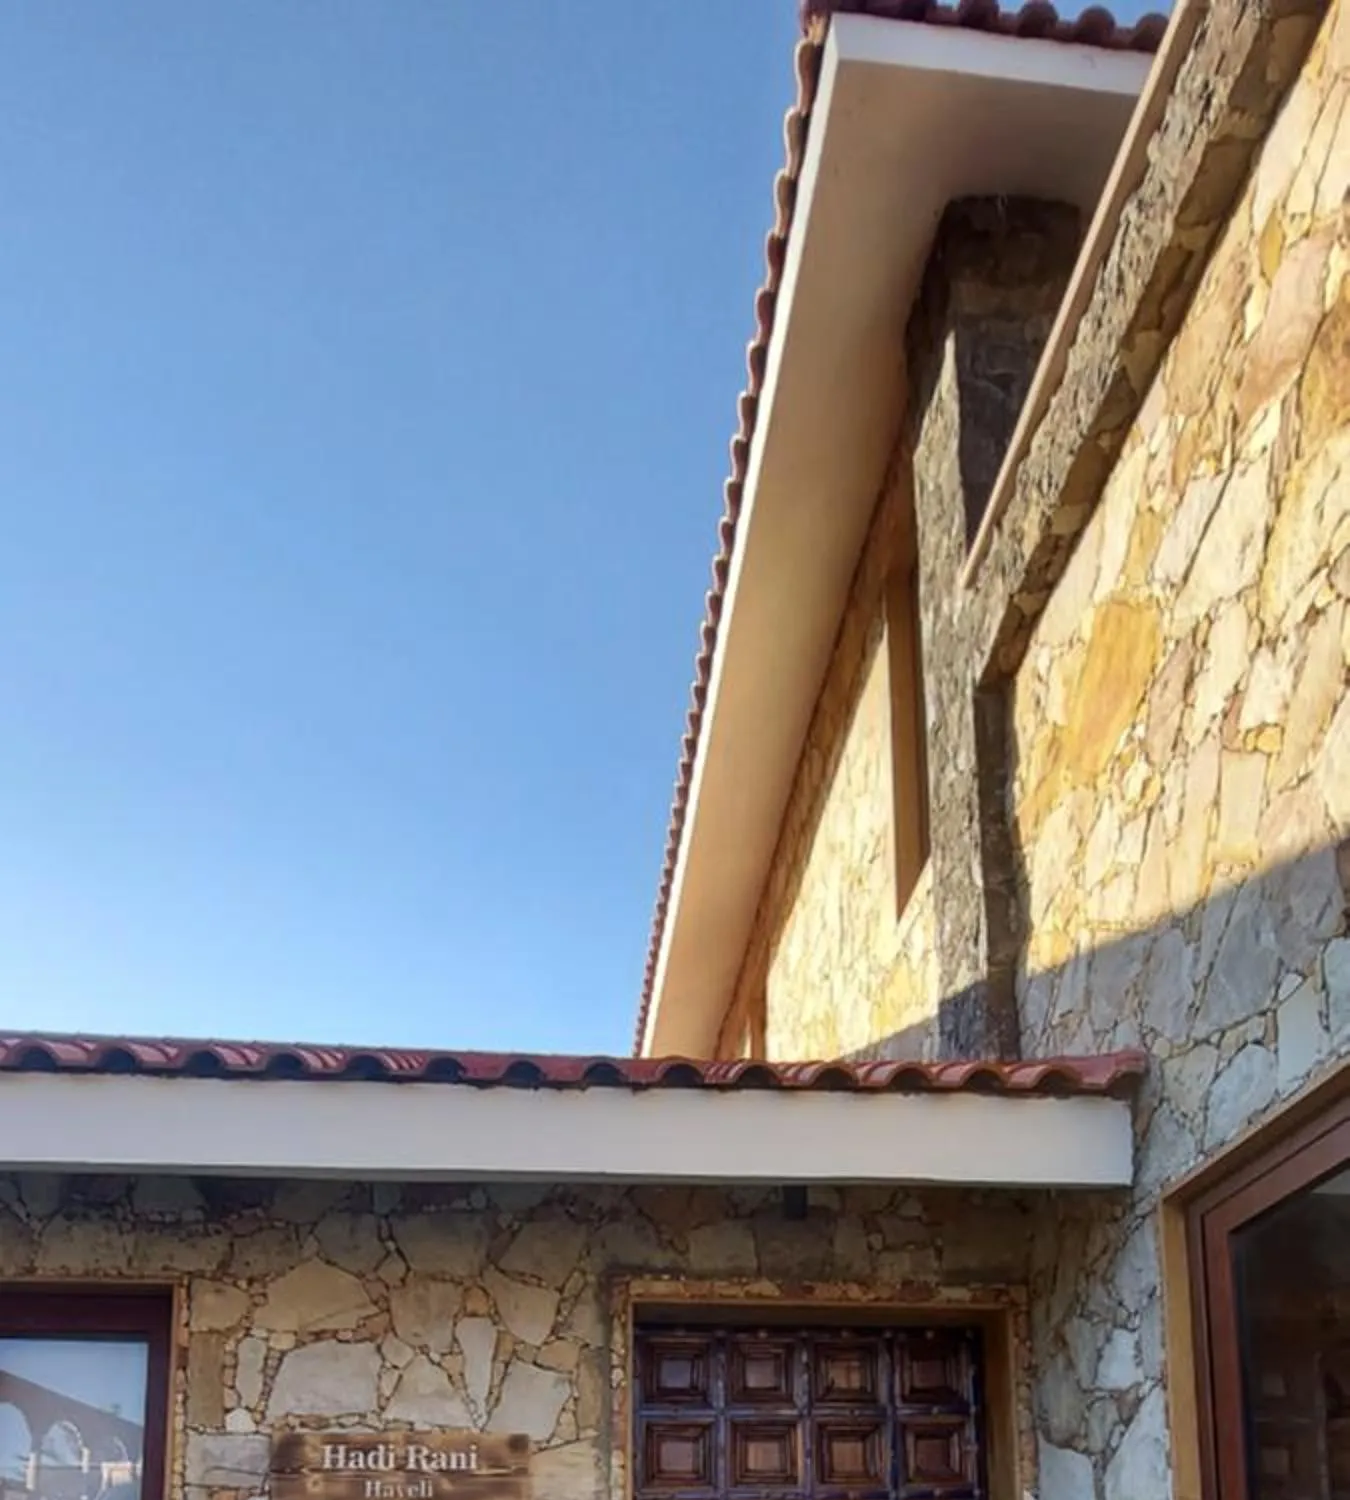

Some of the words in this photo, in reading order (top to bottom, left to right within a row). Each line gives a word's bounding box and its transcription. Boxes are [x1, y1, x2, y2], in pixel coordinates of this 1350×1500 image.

[321, 1443, 396, 1470] Hadi
[405, 1444, 478, 1471] Rani
[364, 1479, 434, 1498] Haveli
